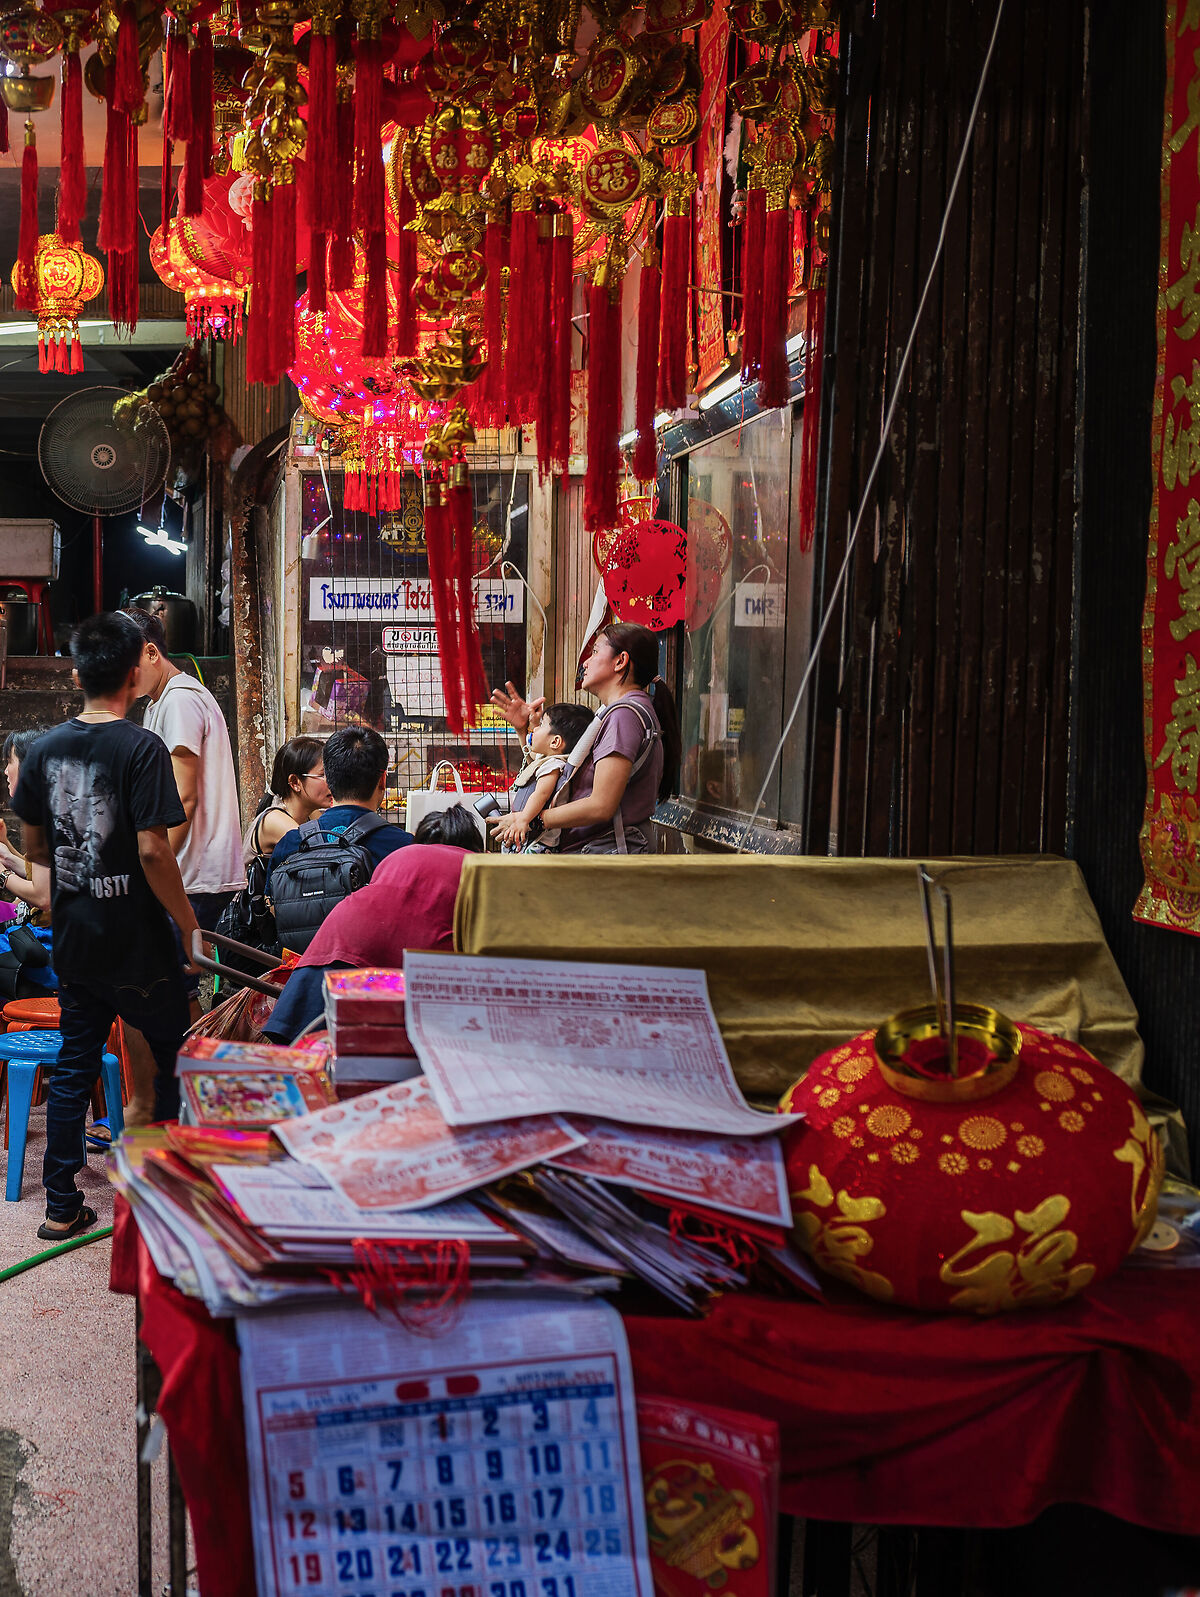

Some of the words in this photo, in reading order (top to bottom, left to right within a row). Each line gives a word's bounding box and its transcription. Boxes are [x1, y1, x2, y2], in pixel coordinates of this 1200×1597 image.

[598, 161, 629, 192] 福
[438, 1413, 447, 1442] 1
[482, 1408, 500, 1436] 2
[533, 1401, 549, 1432] 3
[583, 1397, 599, 1426] 4
[290, 1471, 306, 1500] 5
[337, 1466, 355, 1495] 6
[387, 1460, 403, 1490] 7
[437, 1454, 453, 1485] 8
[486, 1450, 503, 1480] 9
[529, 1443, 562, 1474] 10
[582, 1440, 611, 1471] 11
[285, 1511, 317, 1538] 12
[335, 1508, 367, 1535] 13
[385, 1504, 417, 1532] 14
[434, 1499, 466, 1529] 15
[484, 1493, 517, 1522] 16
[533, 1488, 565, 1519] 17
[584, 1485, 615, 1514] 18
[290, 1554, 322, 1584] 19
[337, 1549, 373, 1582] 20
[388, 1544, 421, 1577] 21
[436, 1540, 472, 1572] 22
[486, 1536, 521, 1566] 23
[535, 1531, 572, 1563] 24
[585, 1528, 622, 1555] 25
